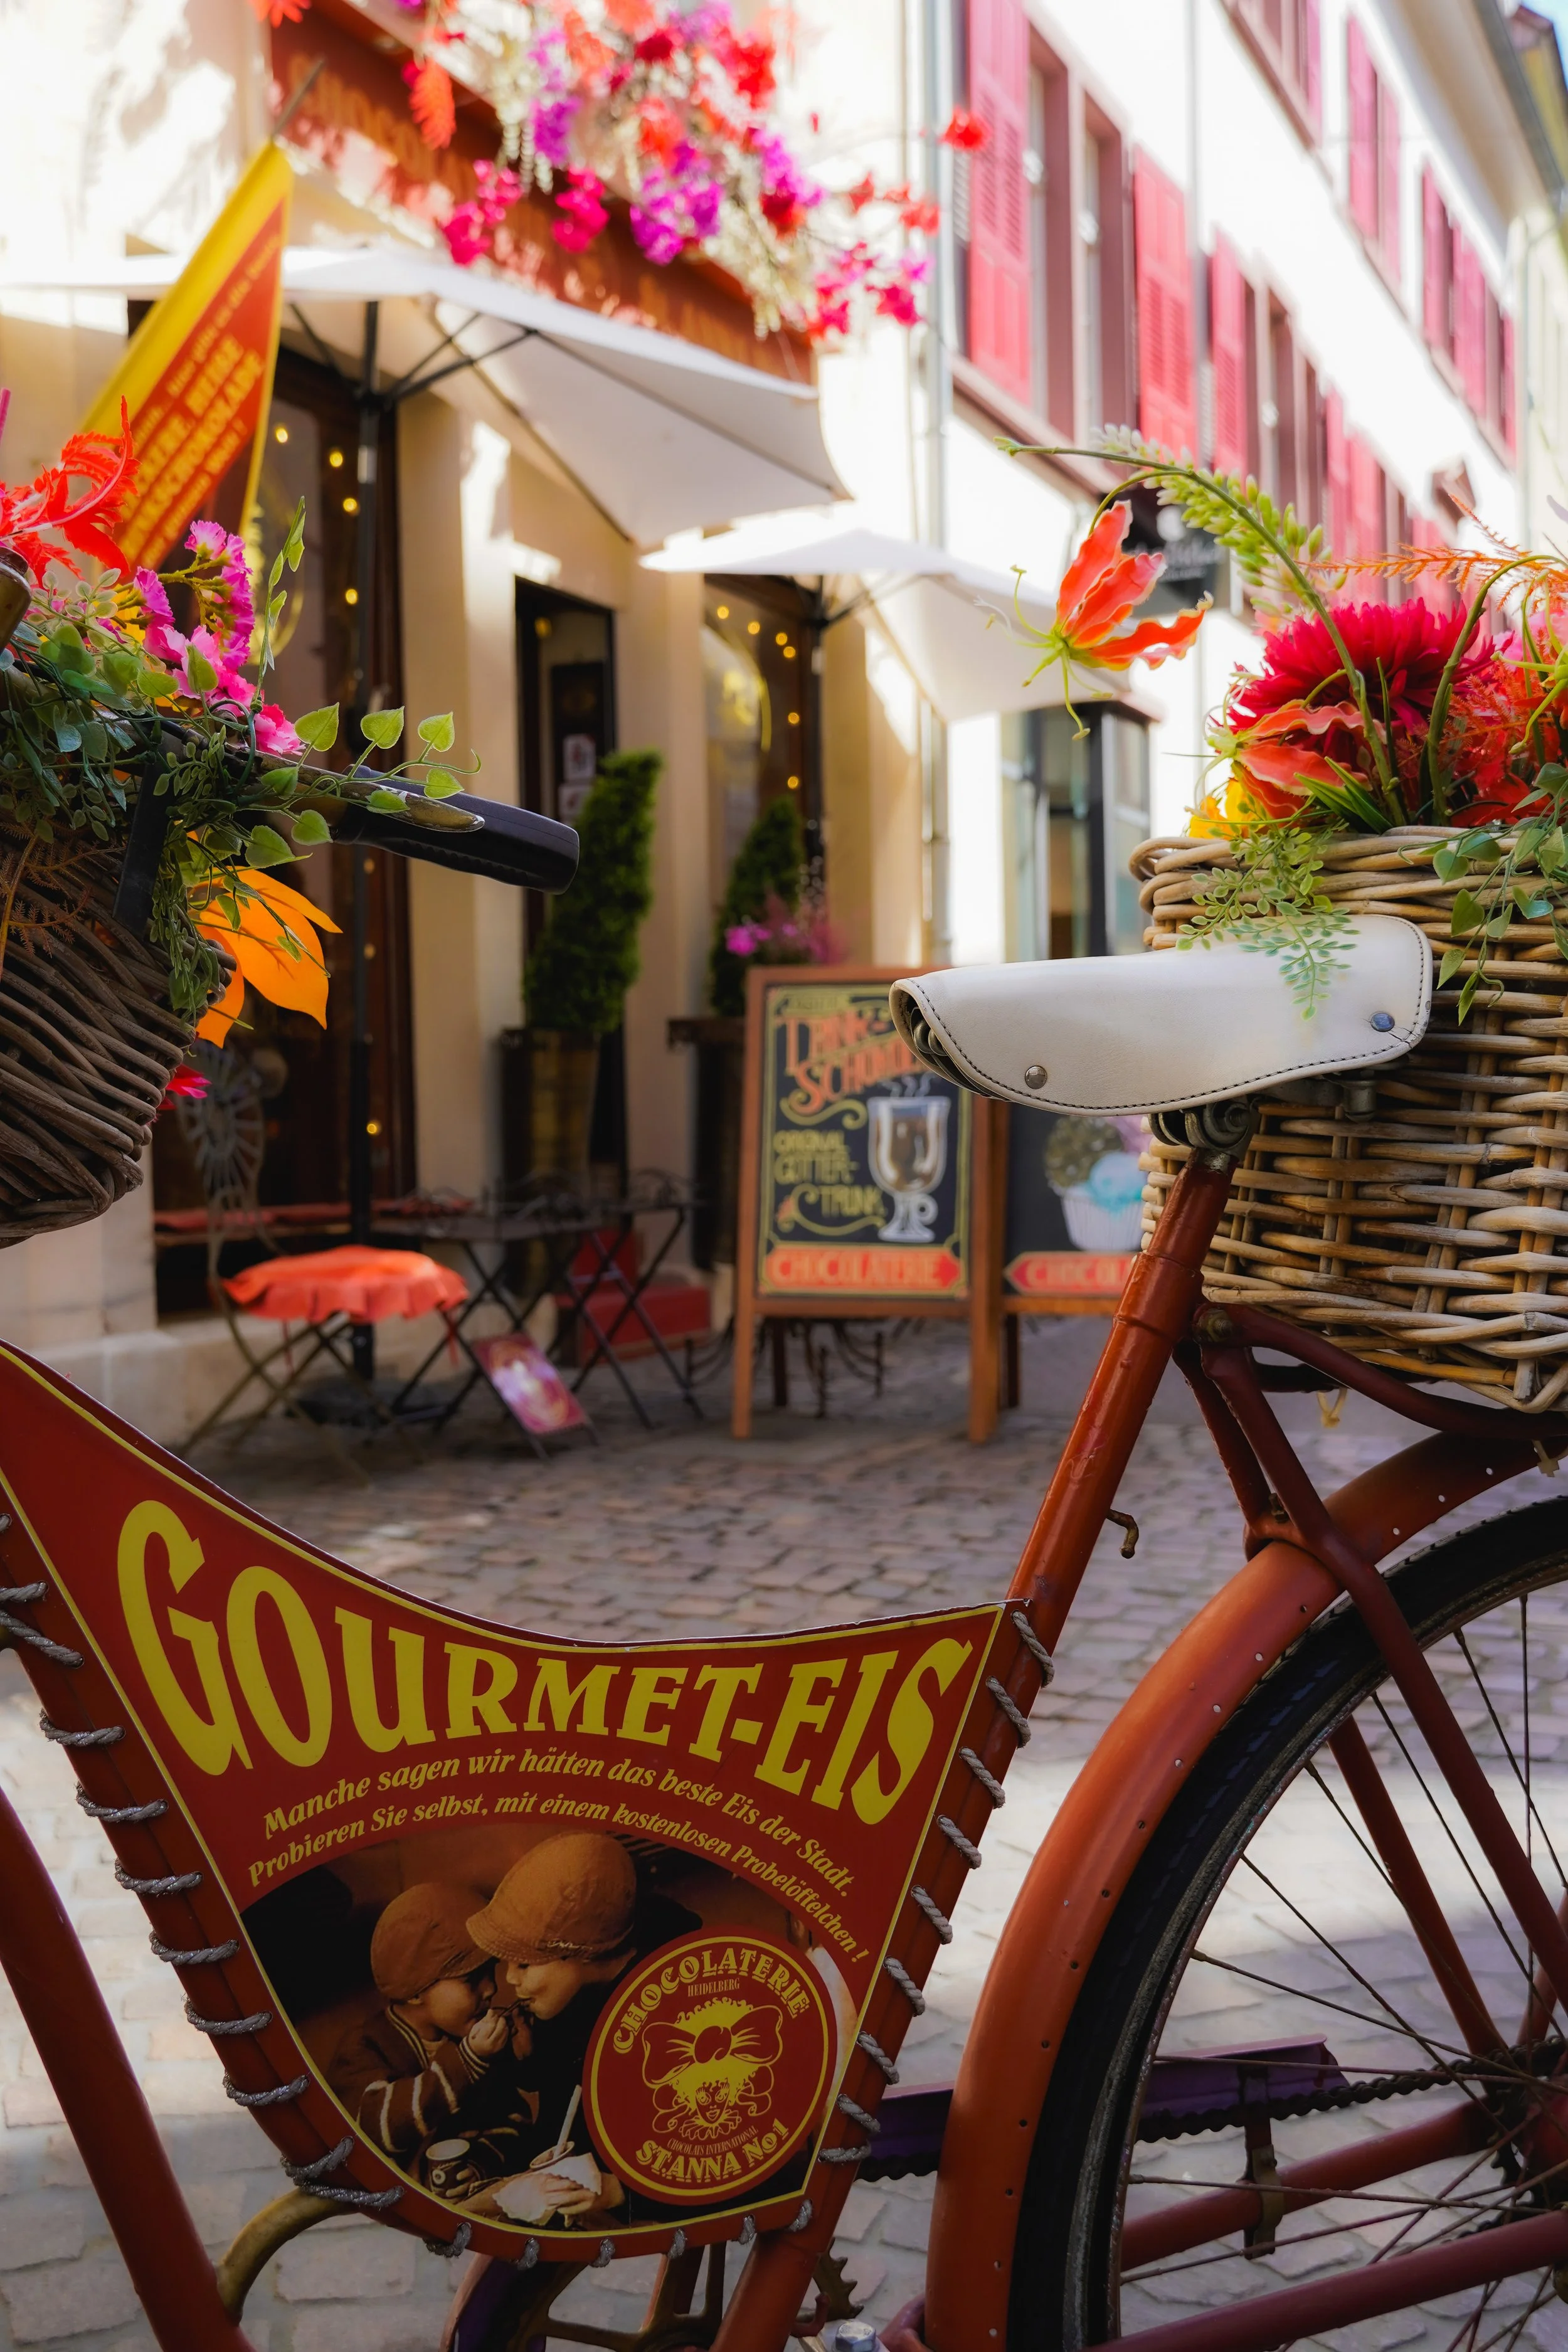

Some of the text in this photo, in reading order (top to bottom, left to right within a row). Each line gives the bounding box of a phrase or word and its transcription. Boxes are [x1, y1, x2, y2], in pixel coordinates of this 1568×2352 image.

[117, 1500, 973, 1825] GOURMET-EIS
[248, 1820, 366, 1887] Probieren
[371, 1804, 408, 1832] Sie
[413, 1793, 489, 1820] selbst,
[494, 1791, 538, 1813] mit
[539, 1793, 610, 1820] einem
[612, 1803, 733, 1857] kostenlosen
[264, 1746, 854, 1897] Manche sagen wir hätten das beste Eis der Stadt.
[613, 1947, 810, 2053] CHOCOLATERIE
[687, 1978, 741, 1998] HEIDELBERG
[706, 2125, 760, 2154] INTERNATIONAL
